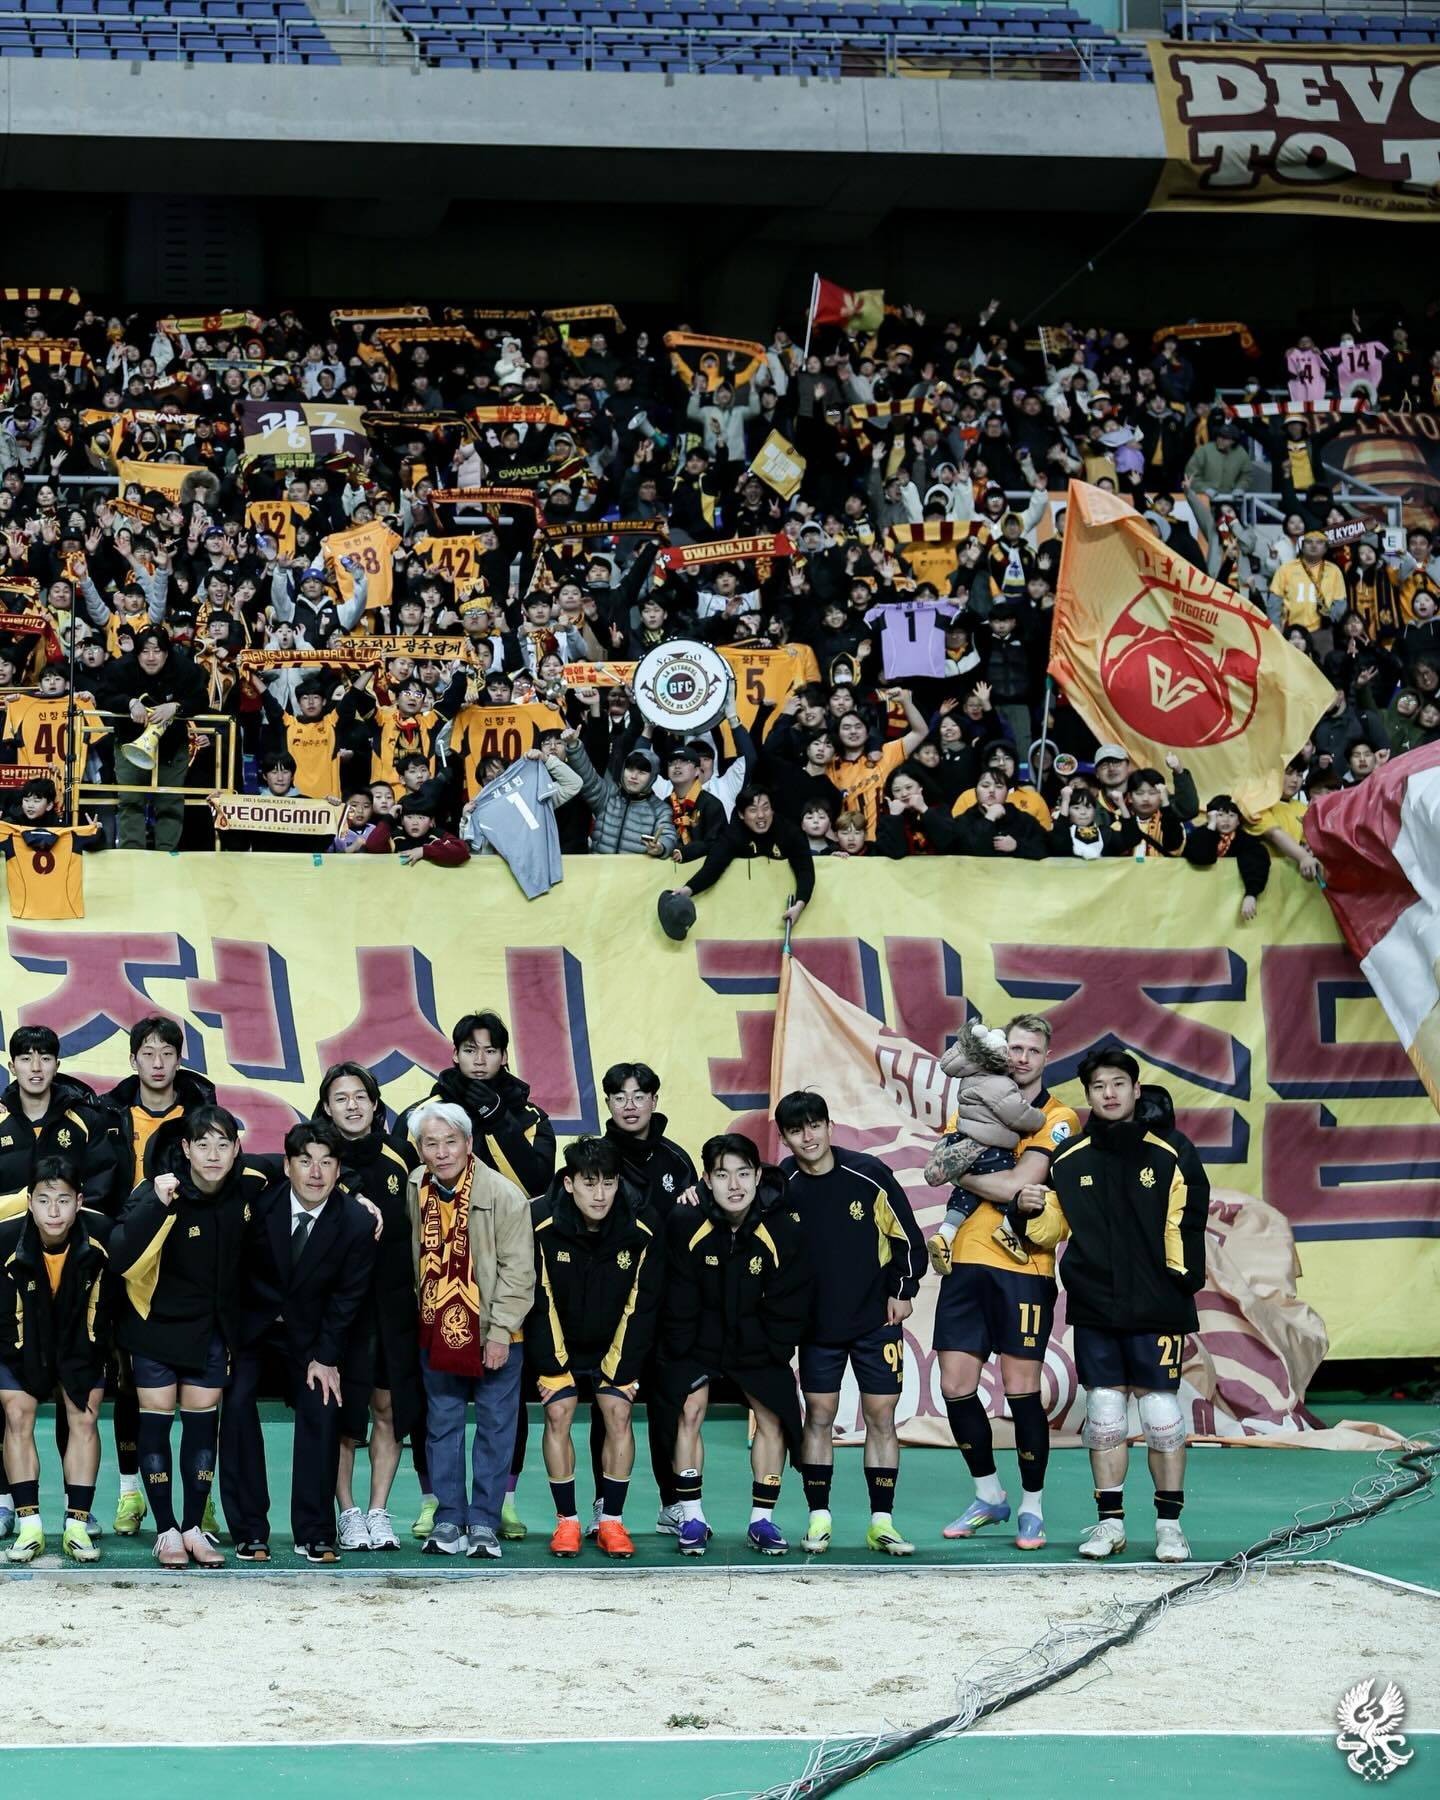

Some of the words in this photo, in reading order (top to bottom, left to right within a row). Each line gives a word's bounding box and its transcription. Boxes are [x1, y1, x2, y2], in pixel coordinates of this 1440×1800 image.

[1197, 130, 1358, 186] TO
[439, 548, 471, 578] 42
[683, 542, 753, 561] GWANGJU
[757, 538, 775, 550] FC
[904, 611, 917, 642] 1
[293, 648, 350, 661] FOOTBALL
[668, 680, 693, 693] GFC
[746, 668, 766, 706] 5
[222, 804, 331, 825] YEONGMIN
[506, 791, 540, 830] 1
[1019, 1303, 1041, 1335] 11
